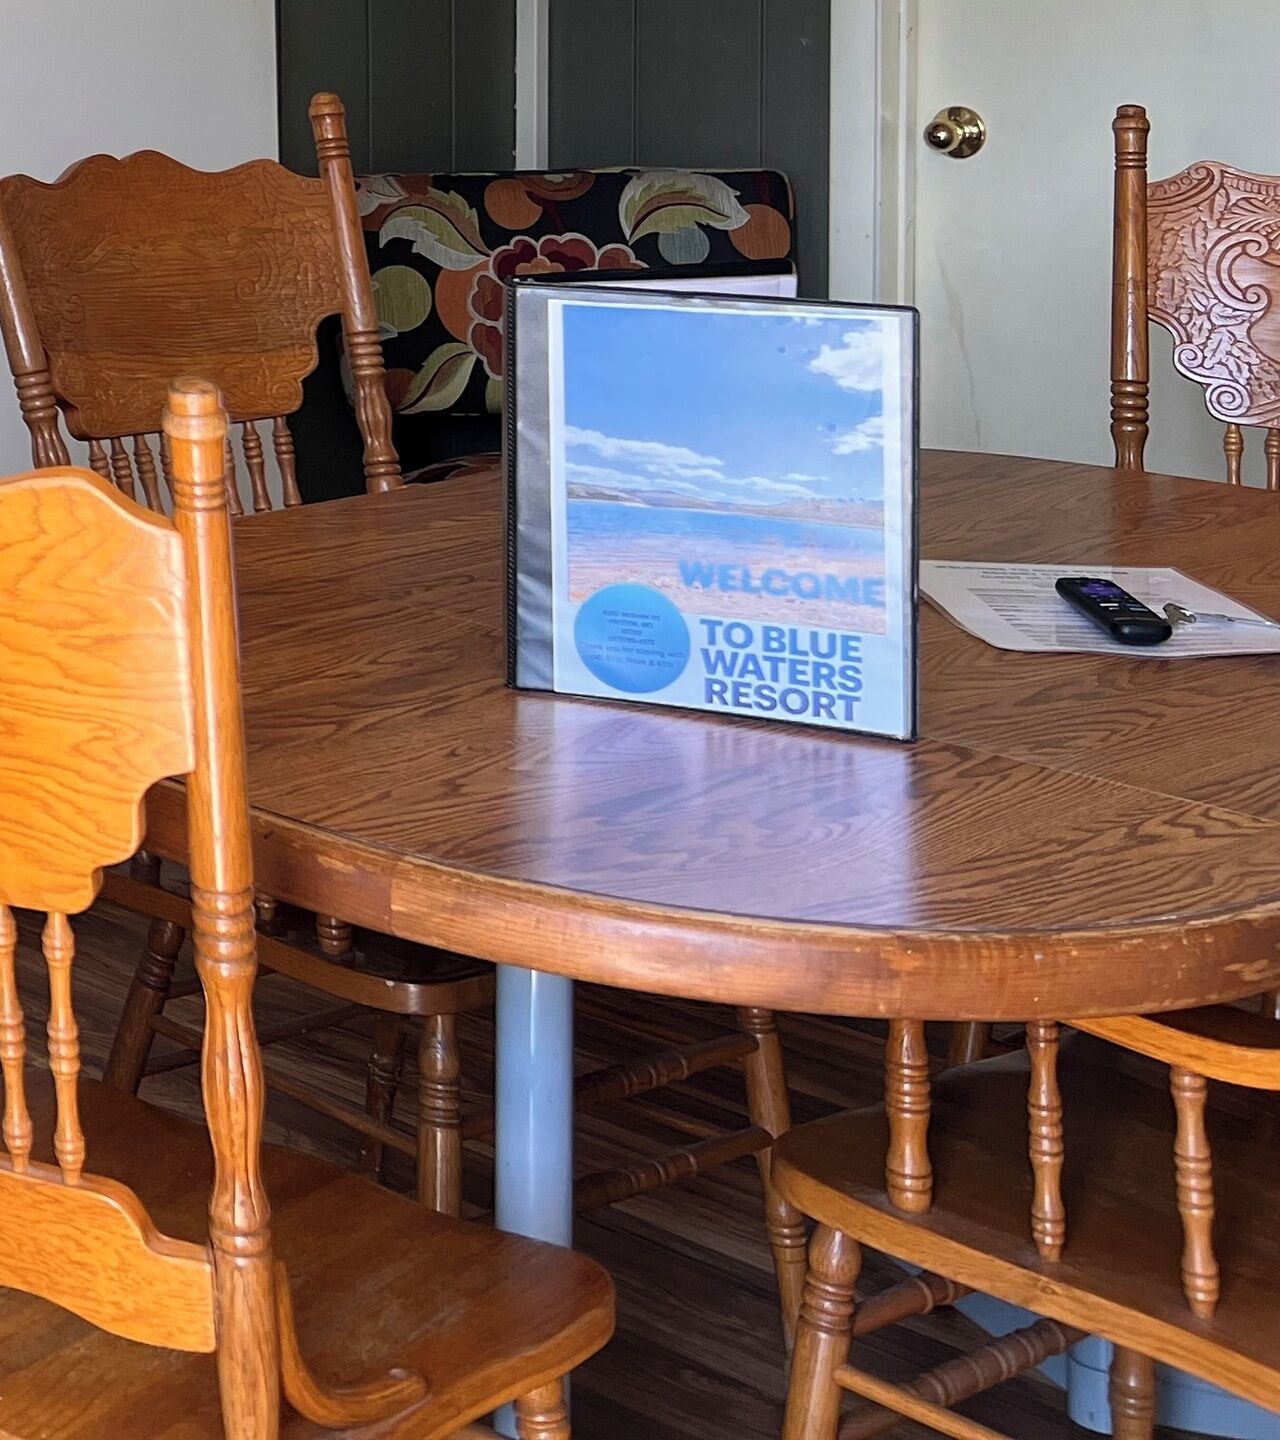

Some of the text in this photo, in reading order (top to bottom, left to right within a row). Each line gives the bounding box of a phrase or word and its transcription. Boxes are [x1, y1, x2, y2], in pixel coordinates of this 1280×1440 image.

[679, 558, 886, 608] WELCOME
[700, 619, 862, 663] TO BLUE
[700, 648, 863, 693] WATERS
[704, 677, 861, 722] RESORT
